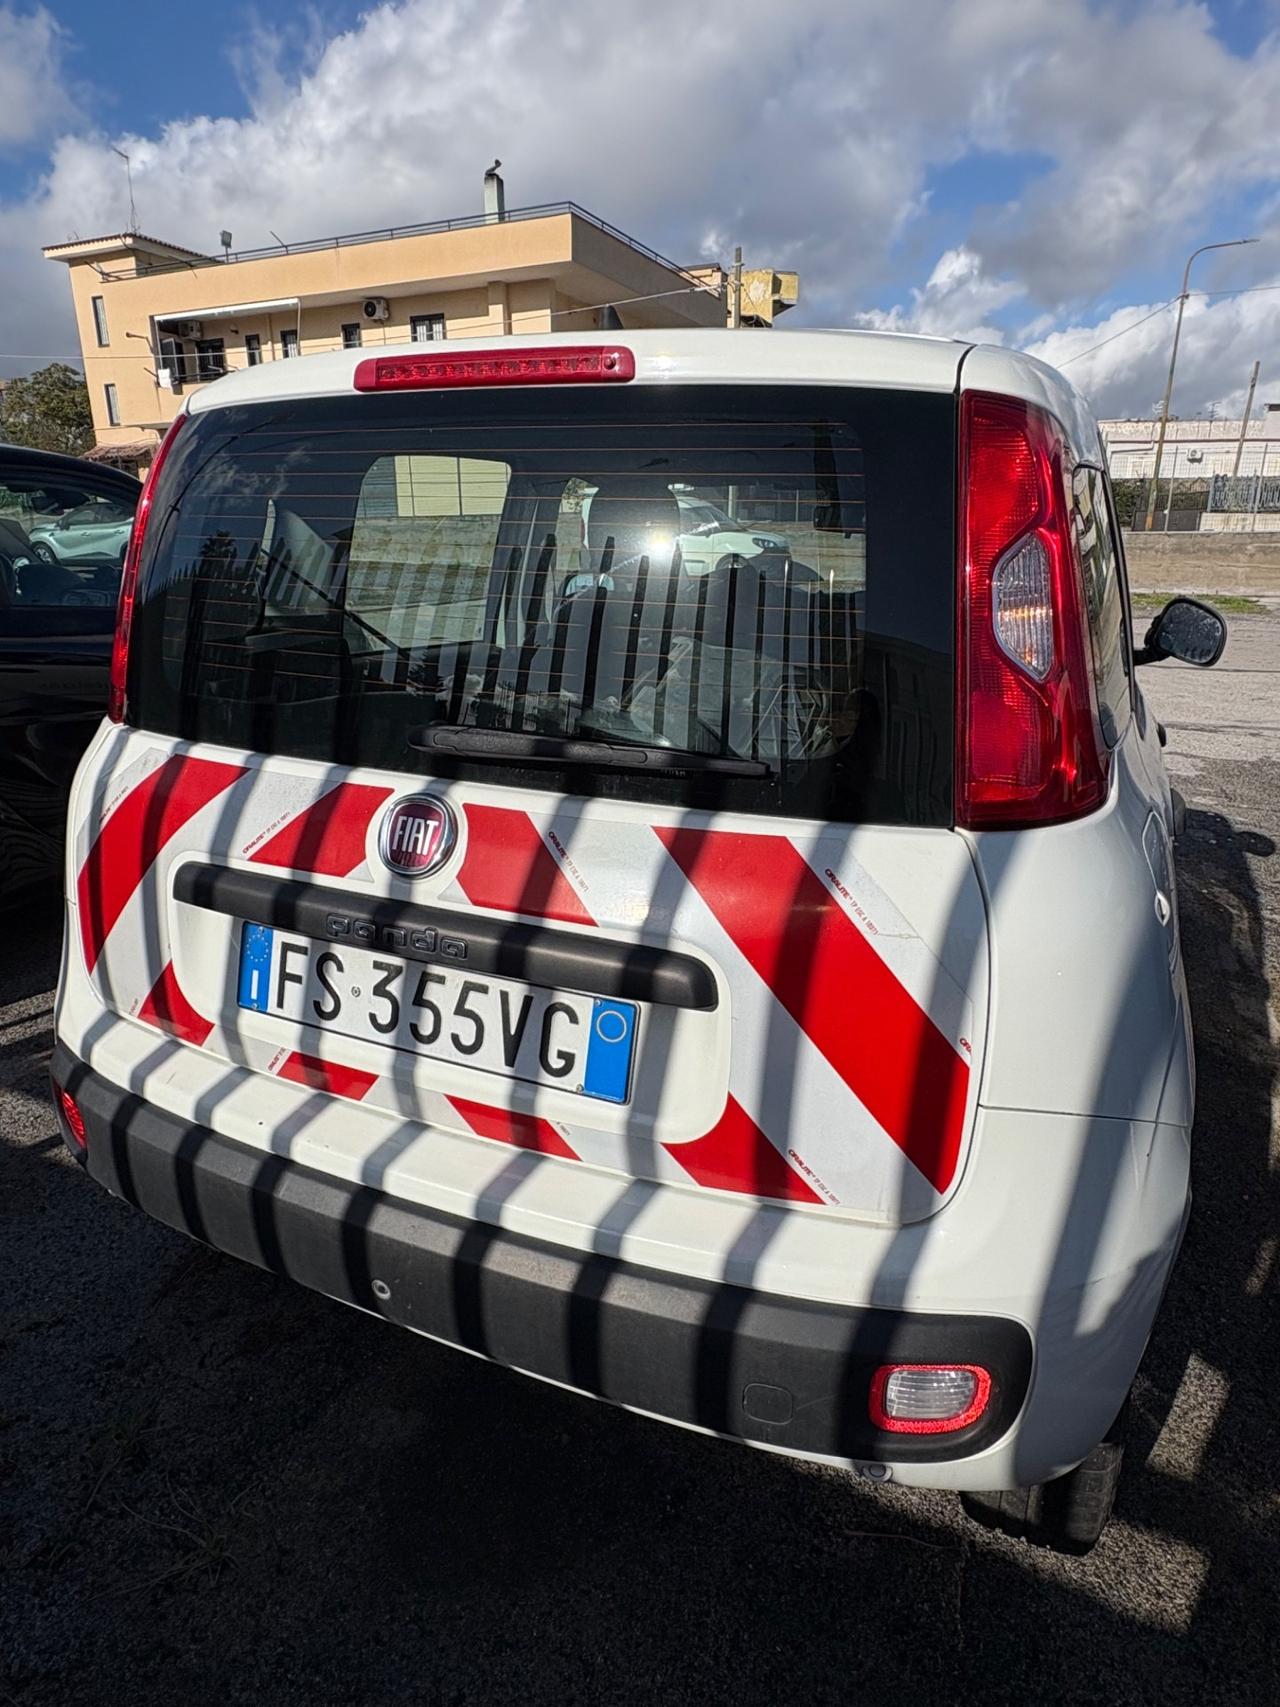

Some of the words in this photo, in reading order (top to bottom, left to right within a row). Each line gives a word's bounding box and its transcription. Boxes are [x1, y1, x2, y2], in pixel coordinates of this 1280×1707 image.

[391, 815, 440, 856] FIAT
[327, 912, 469, 960] panda
[276, 941, 345, 1022] FS
[369, 960, 580, 1078] 355VG
